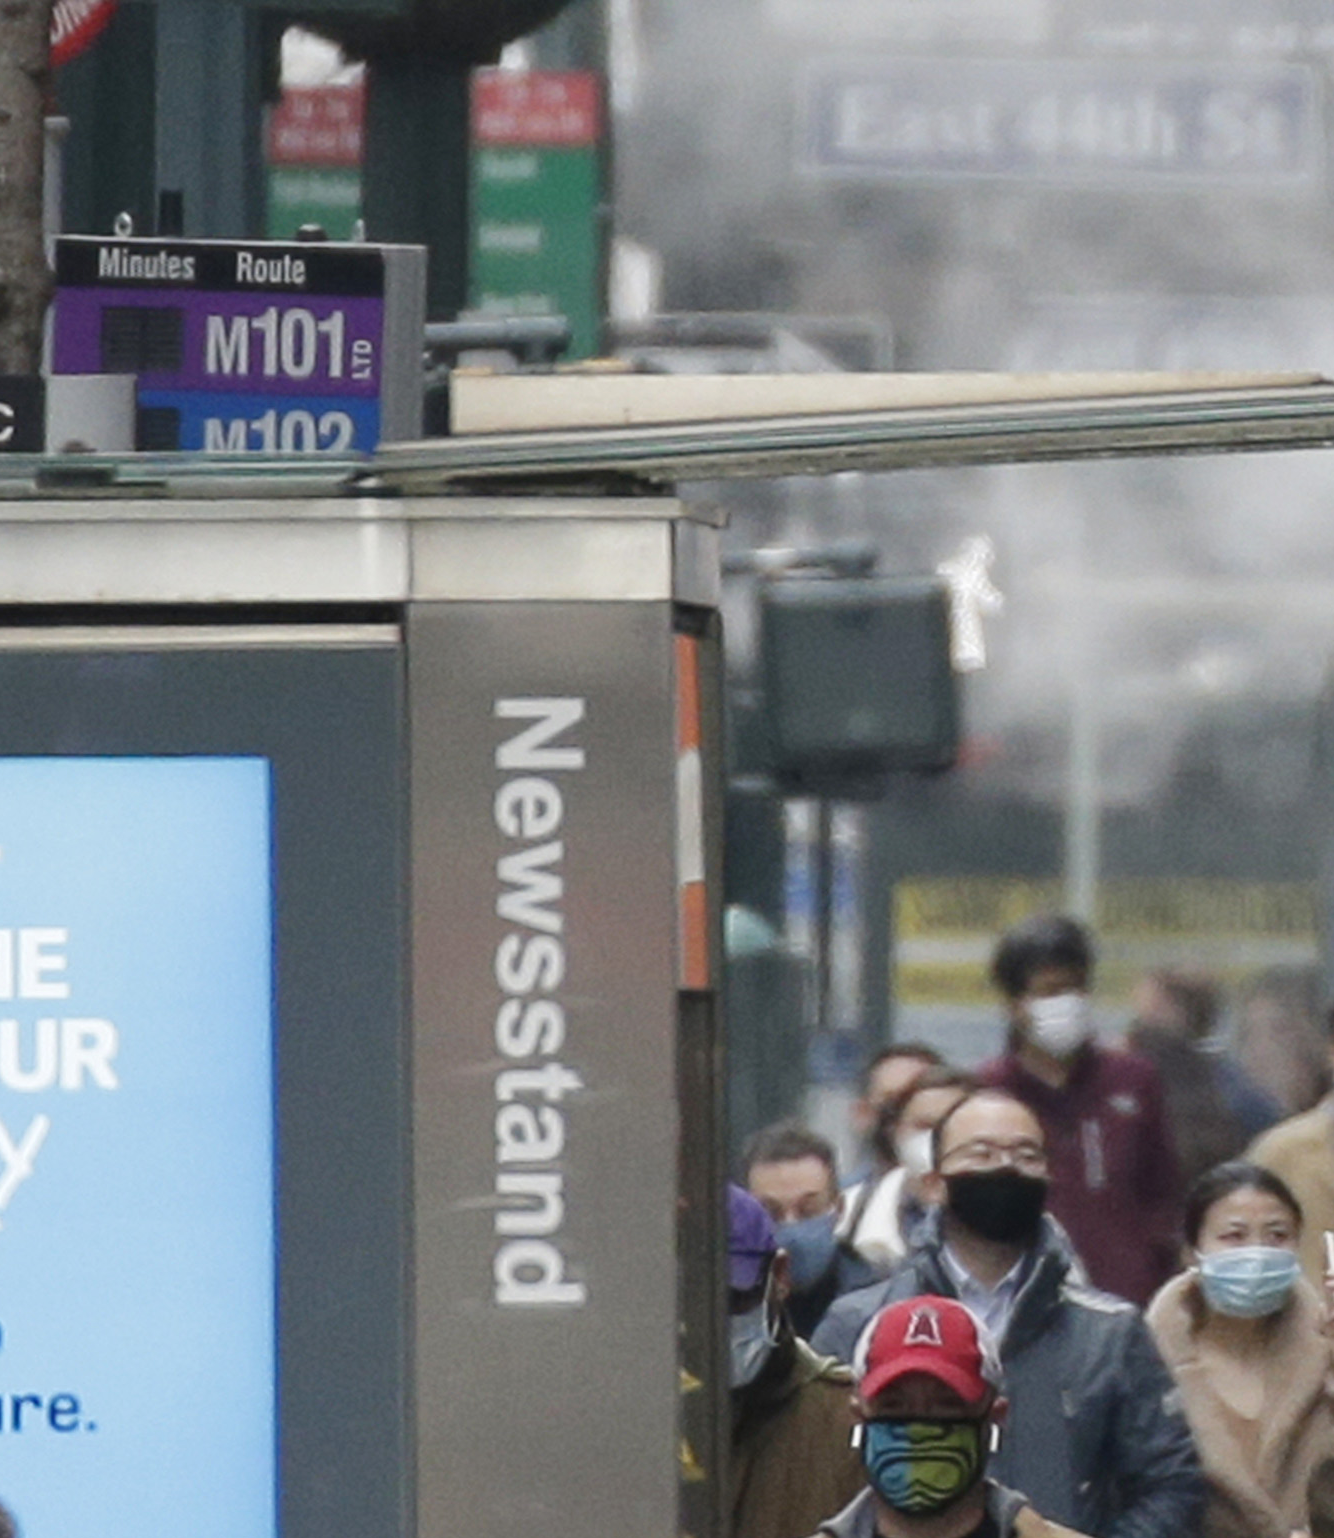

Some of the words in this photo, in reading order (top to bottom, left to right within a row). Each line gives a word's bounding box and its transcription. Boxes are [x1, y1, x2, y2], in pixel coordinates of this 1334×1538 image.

[98, 247, 196, 280] Minutes
[235, 251, 307, 285] Route
[205, 306, 345, 379] M101
[351, 339, 373, 380] LTD
[493, 697, 587, 1307] Newsstand
